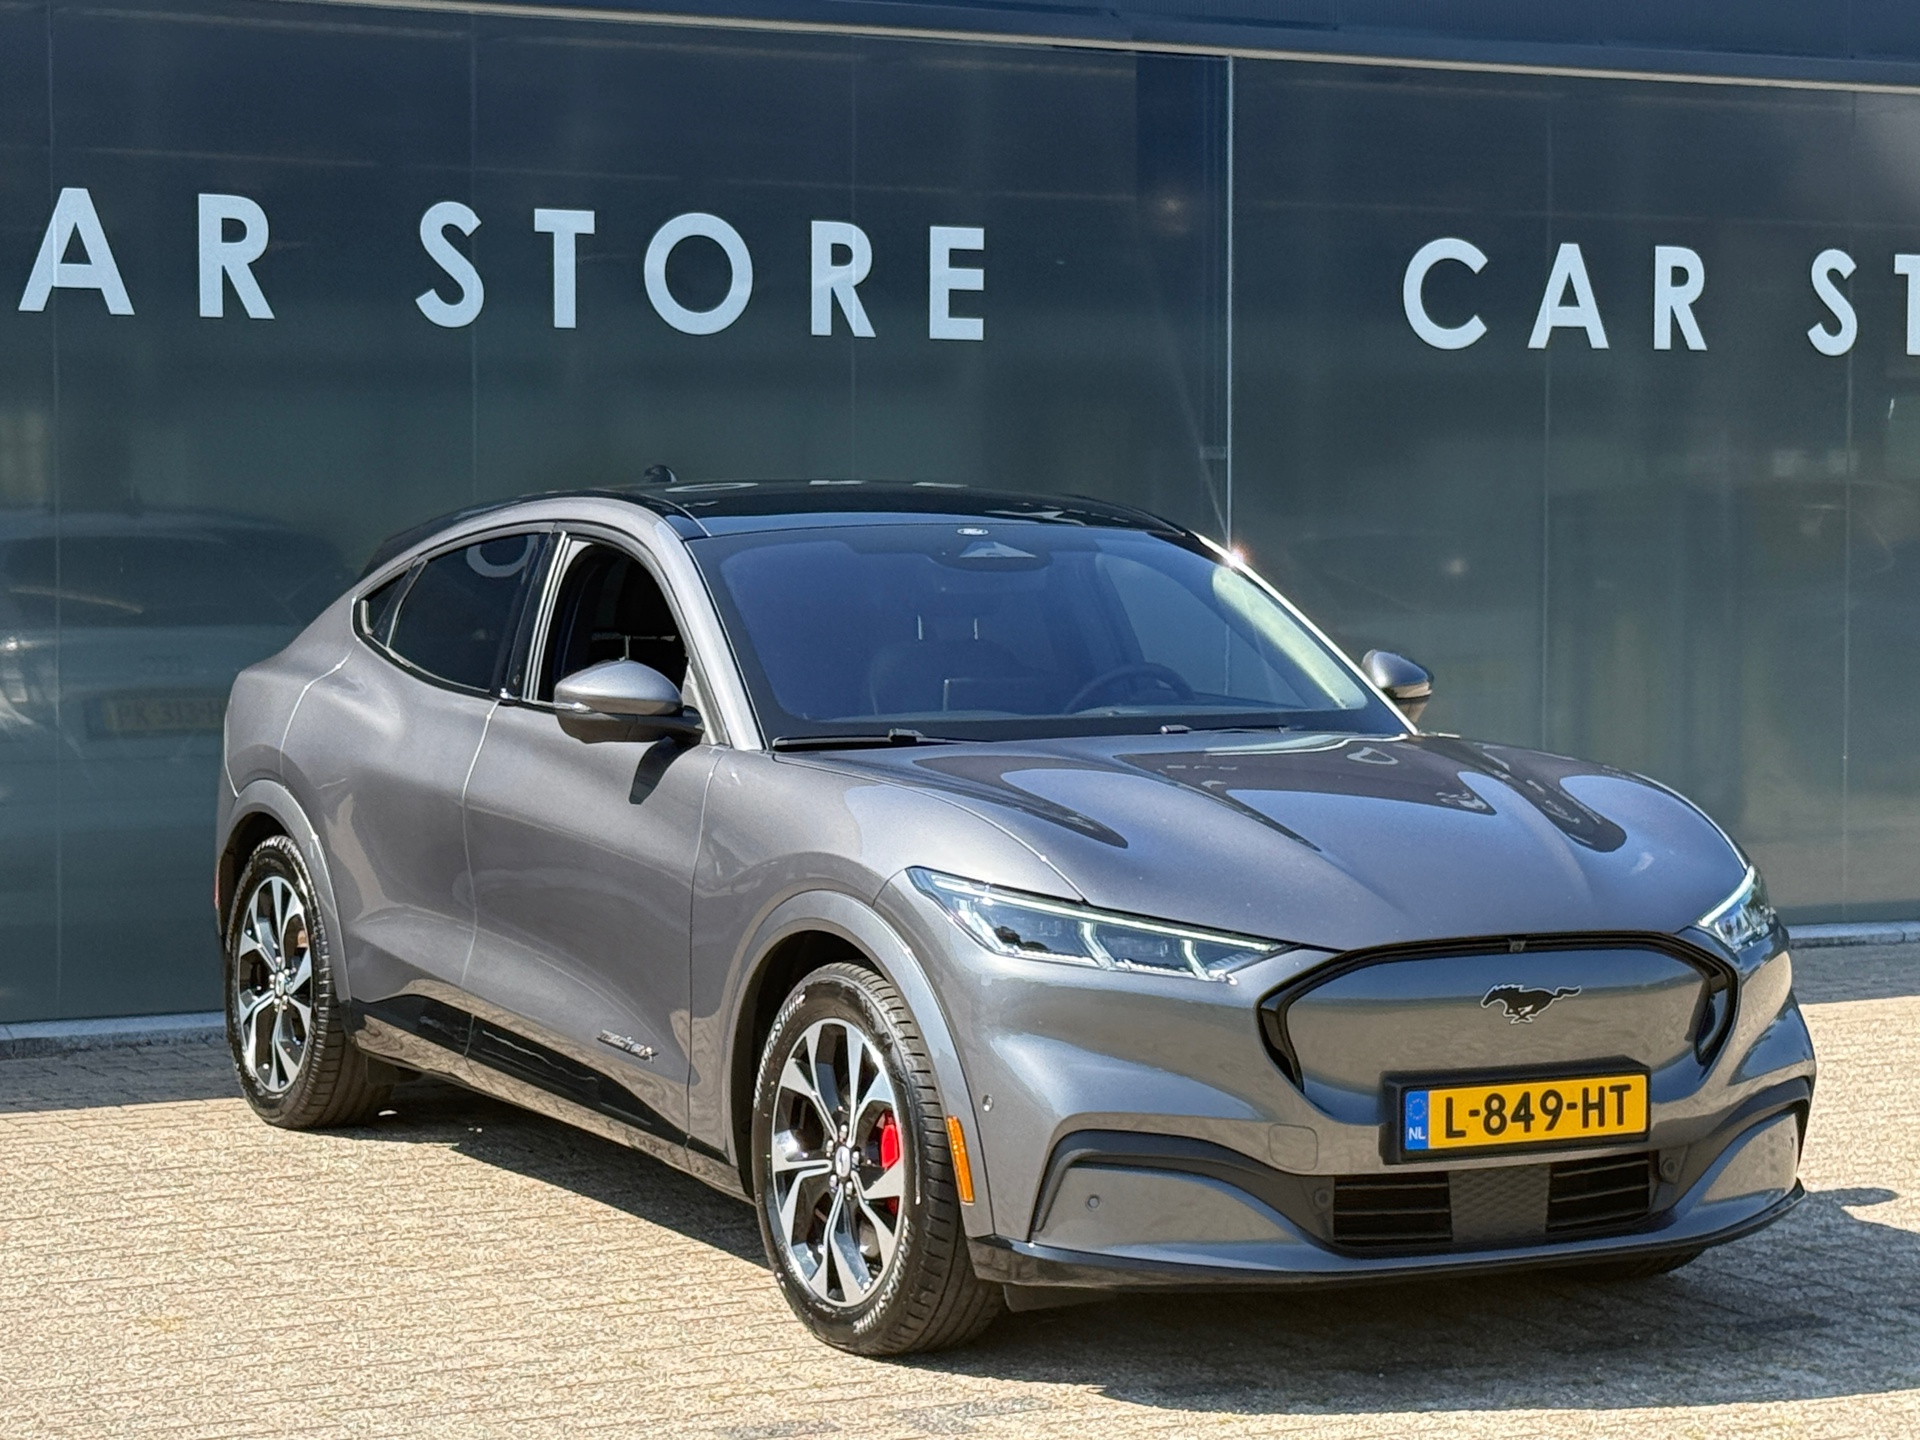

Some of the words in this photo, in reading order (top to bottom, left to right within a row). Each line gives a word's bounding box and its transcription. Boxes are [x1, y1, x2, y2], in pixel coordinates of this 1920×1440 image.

[18, 187, 275, 319] AR
[415, 201, 985, 341] STORE
[1403, 237, 1707, 351] CAR
[1408, 1126, 1426, 1141] NL
[1445, 1084, 1632, 1139] L-849-HT
